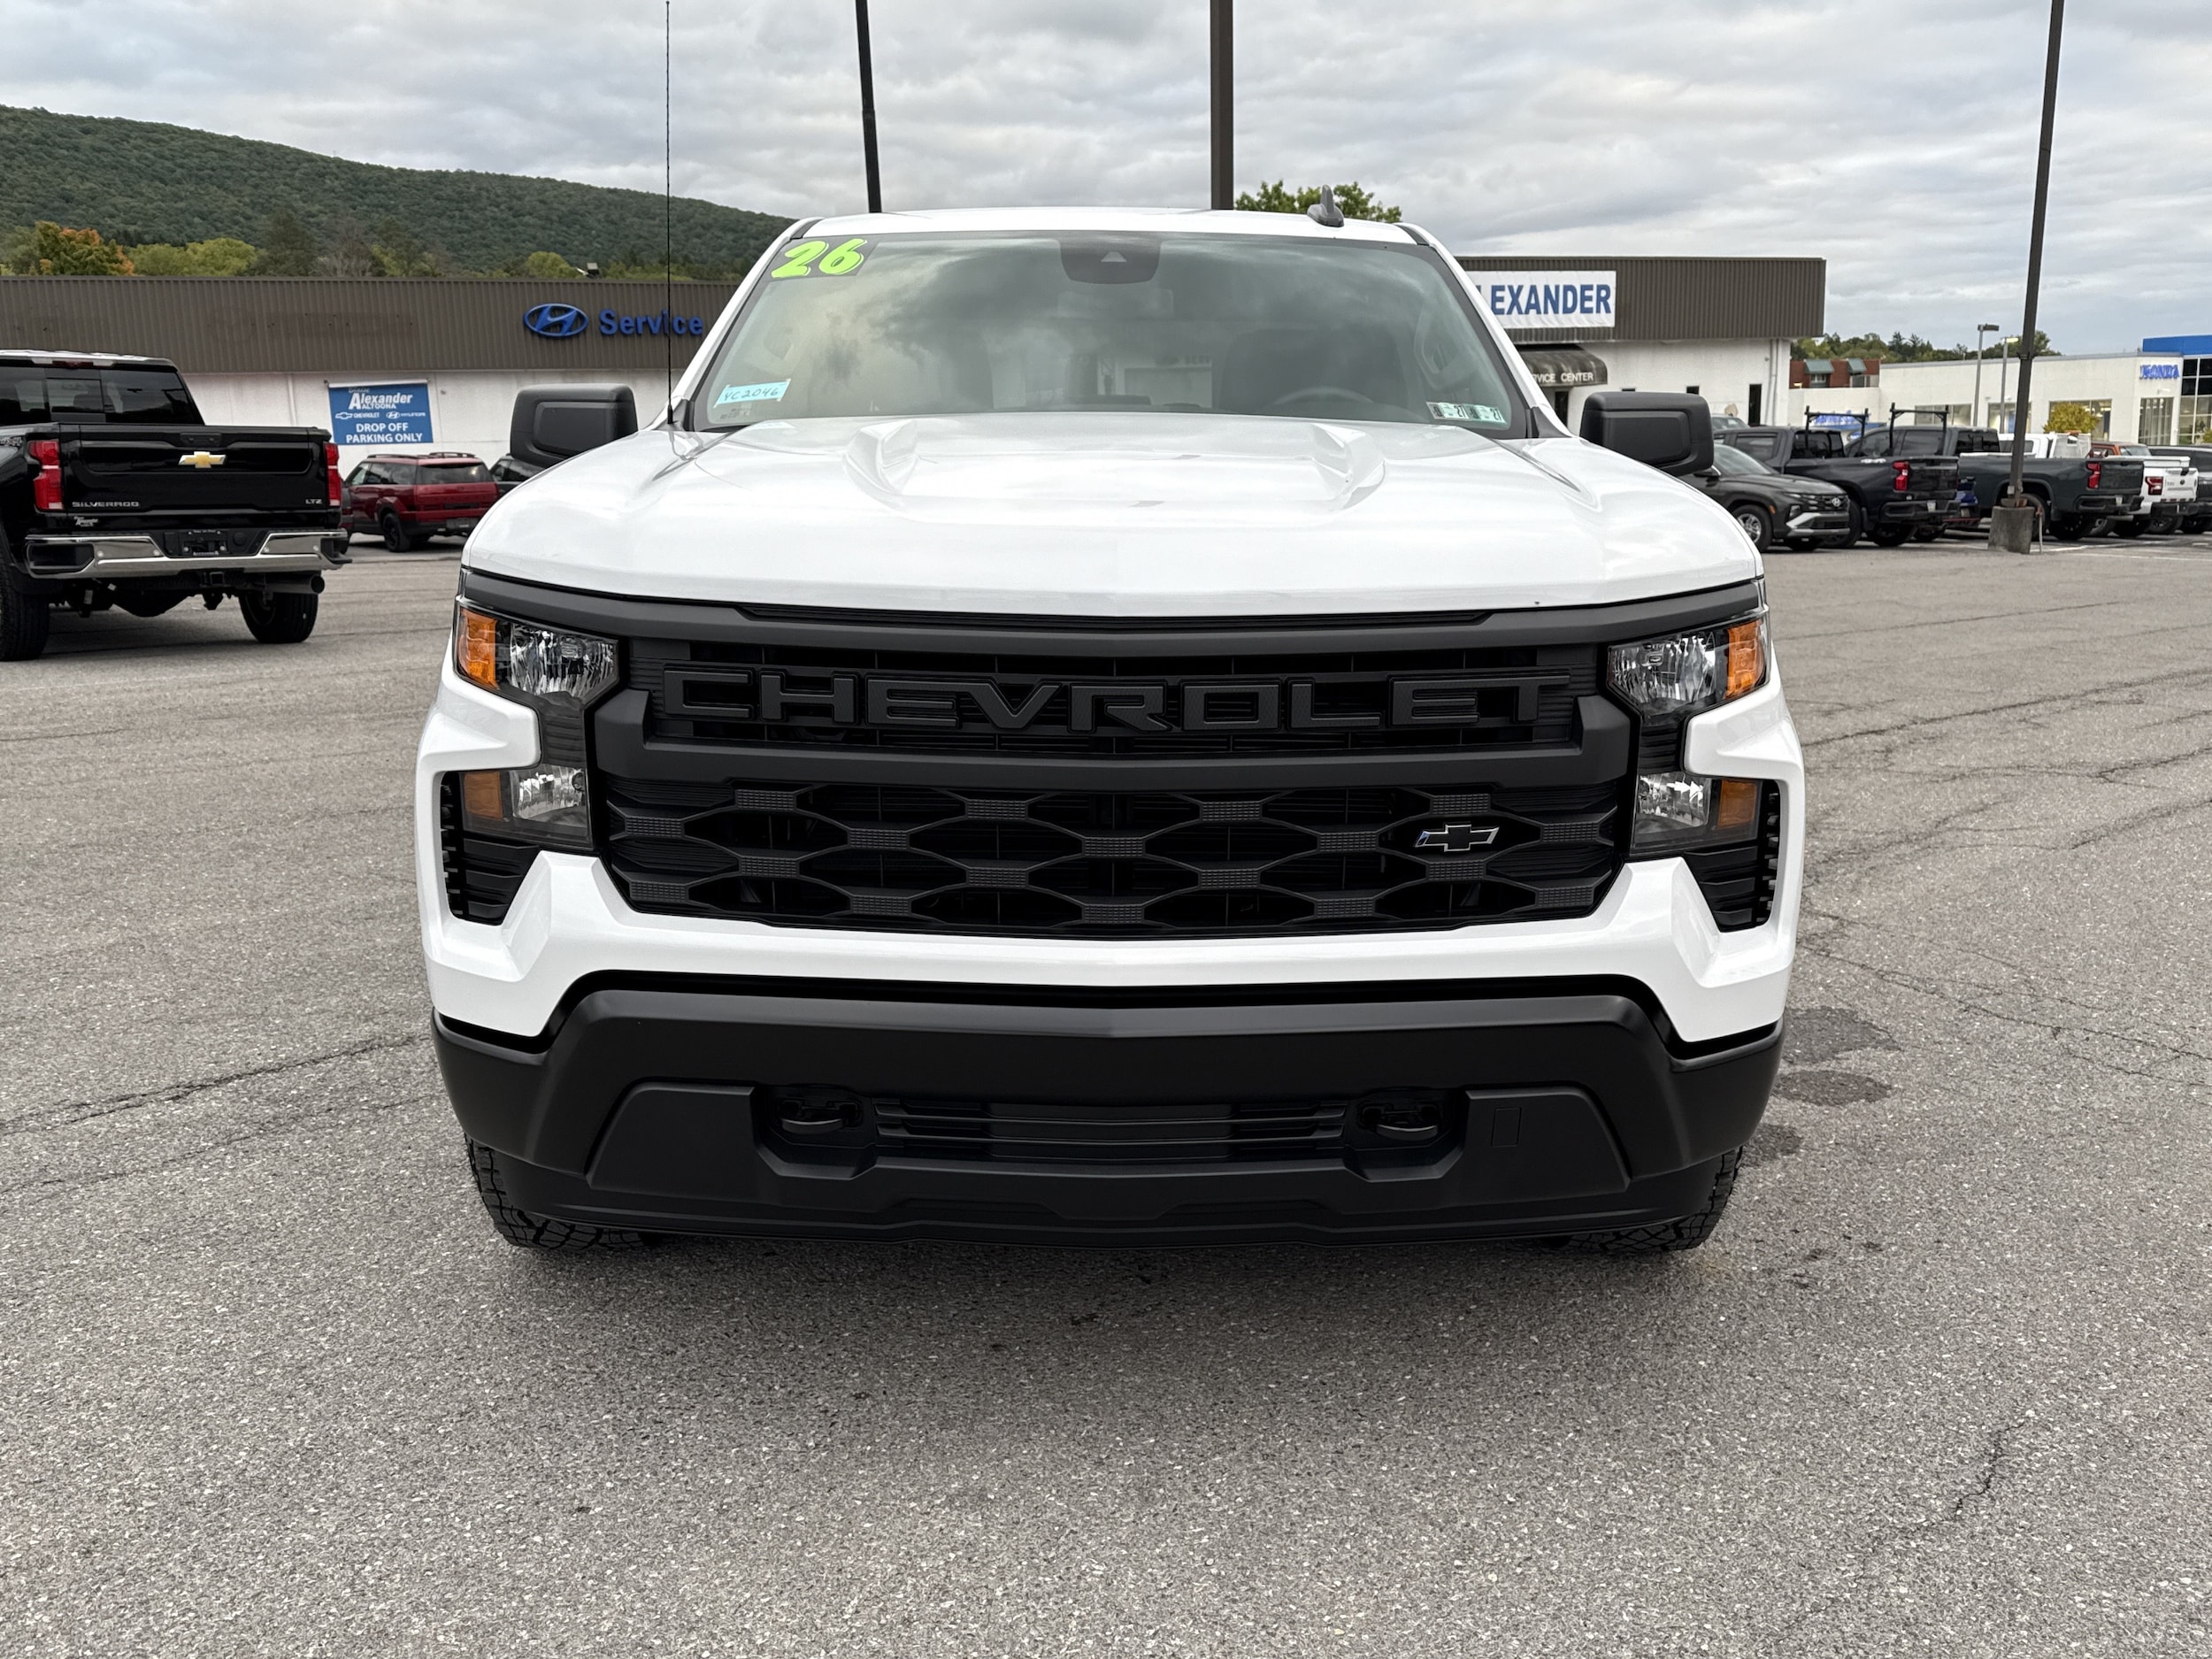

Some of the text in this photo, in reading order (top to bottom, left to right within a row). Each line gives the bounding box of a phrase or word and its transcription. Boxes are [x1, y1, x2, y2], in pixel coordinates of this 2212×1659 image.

[771, 238, 867, 278] 26
[1476, 284, 1612, 315] EXANDER
[599, 308, 703, 335] Service
[1560, 372, 1594, 382] CENTER
[348, 392, 413, 410] Alexander
[346, 433, 423, 443] PARKING ONLY
[356, 422, 409, 433] DROP OFF
[664, 667, 1571, 733] CHEVROLET
